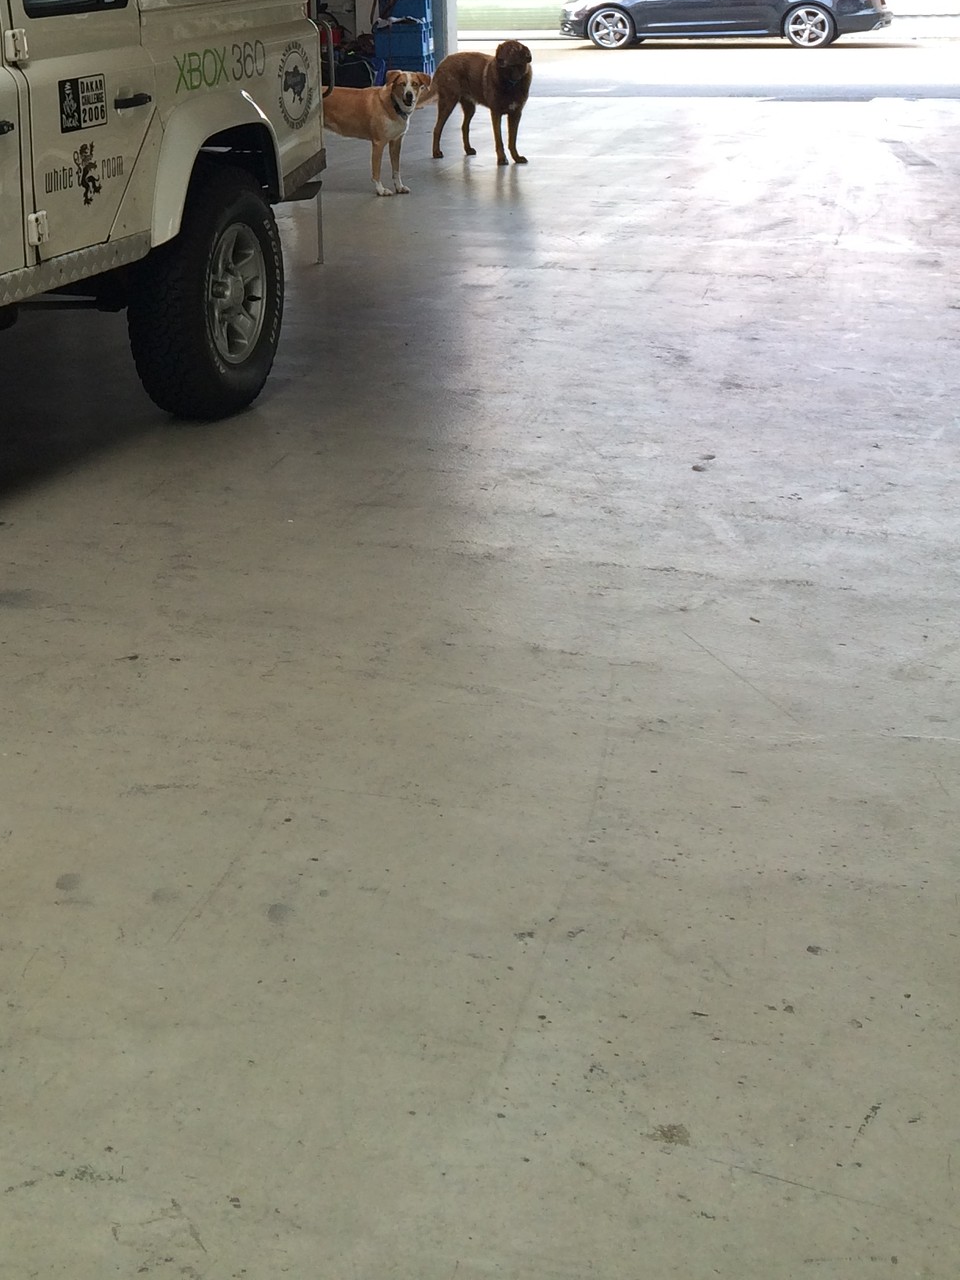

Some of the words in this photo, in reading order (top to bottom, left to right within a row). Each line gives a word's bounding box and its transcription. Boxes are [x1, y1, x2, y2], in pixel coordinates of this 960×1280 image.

[173, 46, 230, 94] XBOX
[231, 39, 266, 81] 360
[80, 79, 104, 95] DAKAR
[82, 104, 106, 124] 2006
[45, 166, 74, 194] white
[101, 155, 124, 180] room
